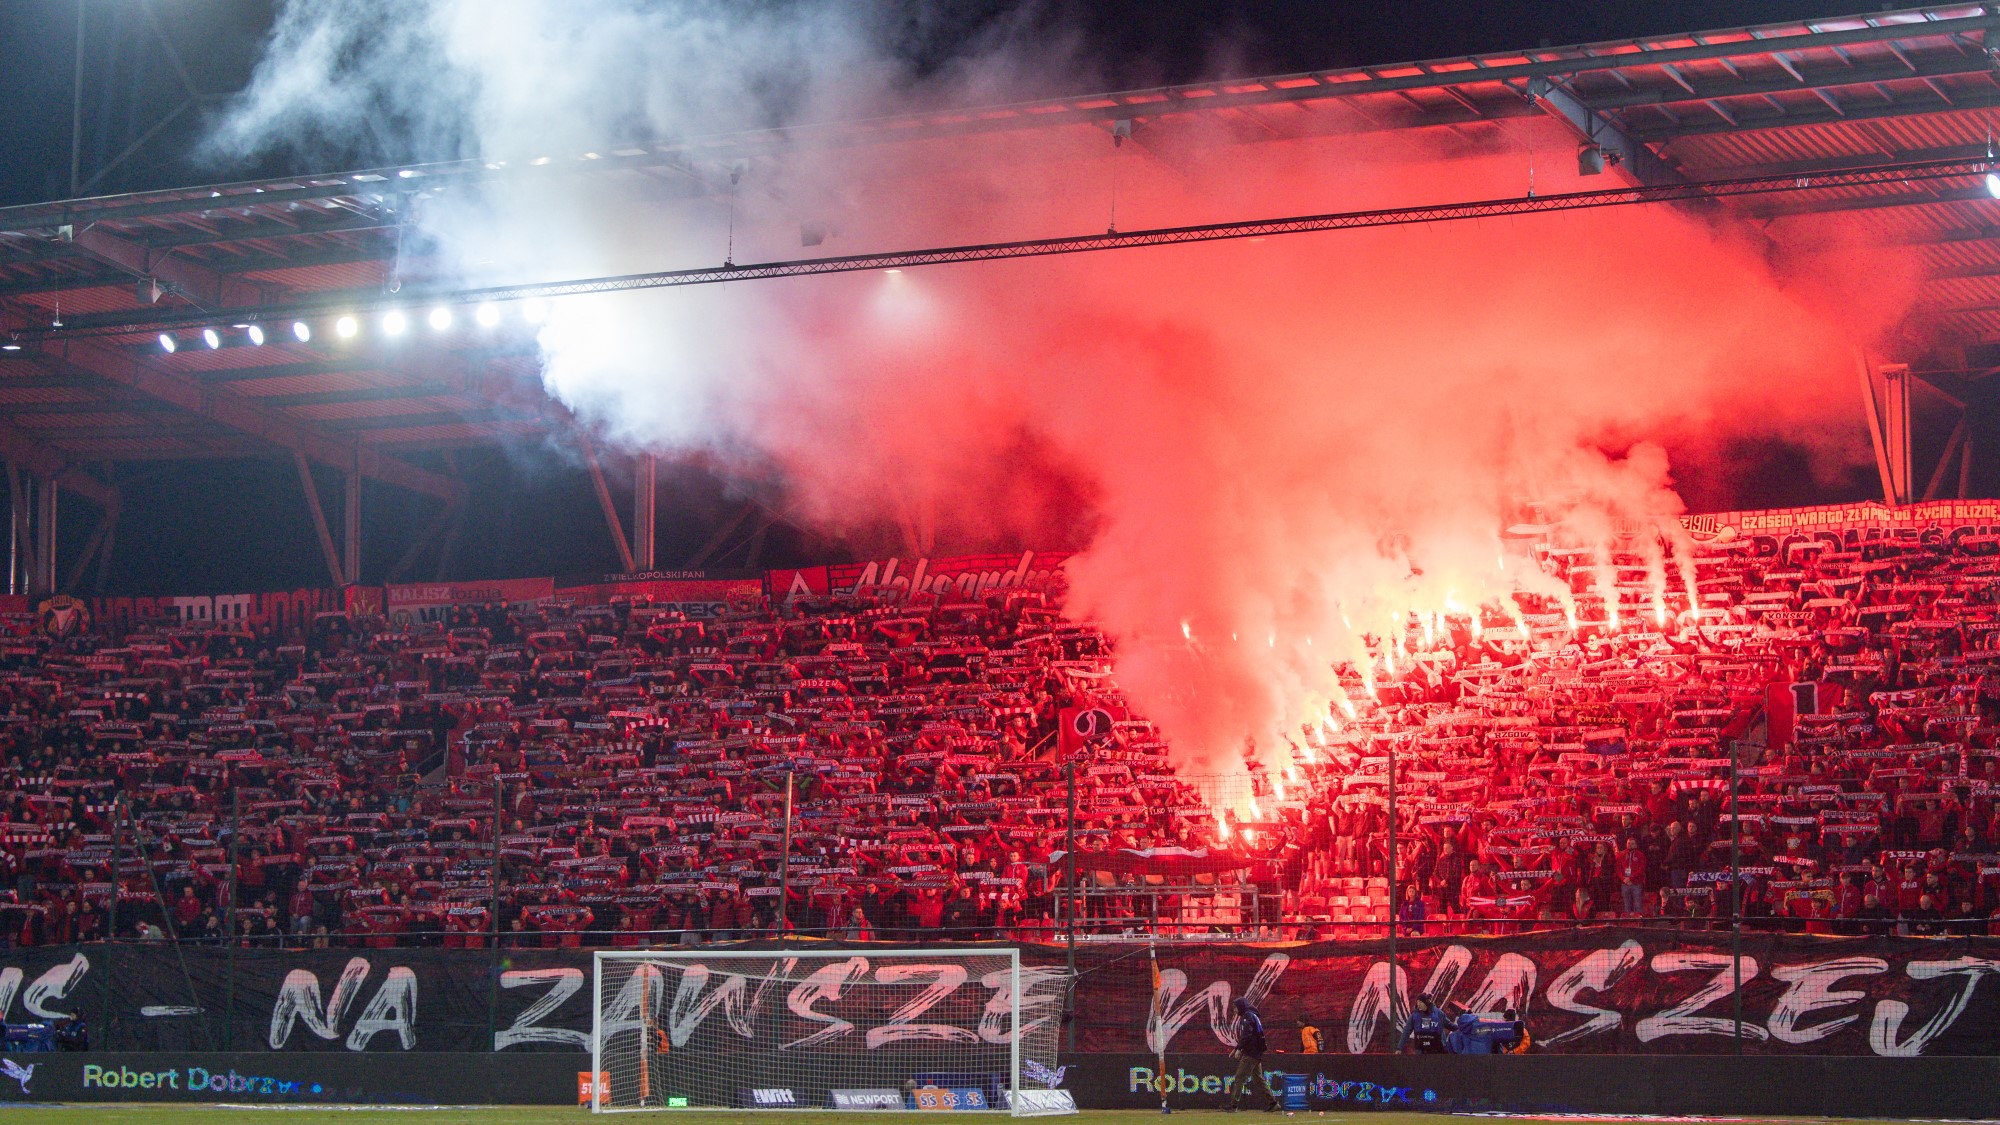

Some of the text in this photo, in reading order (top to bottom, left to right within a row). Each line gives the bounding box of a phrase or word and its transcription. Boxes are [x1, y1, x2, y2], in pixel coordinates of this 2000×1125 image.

[1742, 514, 1793, 529] CZASEM
[1915, 505, 1952, 521] ŻYCIA
[683, 570, 705, 579] FANI
[801, 680, 838, 688] WIDZEW
[1873, 690, 1917, 702] RTS
[835, 771, 878, 779] WID ZEW
[270, 957, 417, 1051] NA
[495, 957, 1078, 1051] ZAWSZE
[1147, 953, 1290, 1054] W
[1348, 939, 2000, 1056] NASZEJ
[84, 1065, 178, 1089] Robert
[851, 1094, 900, 1105] NEWPORT
[920, 1092, 983, 1107] STS STS STS
